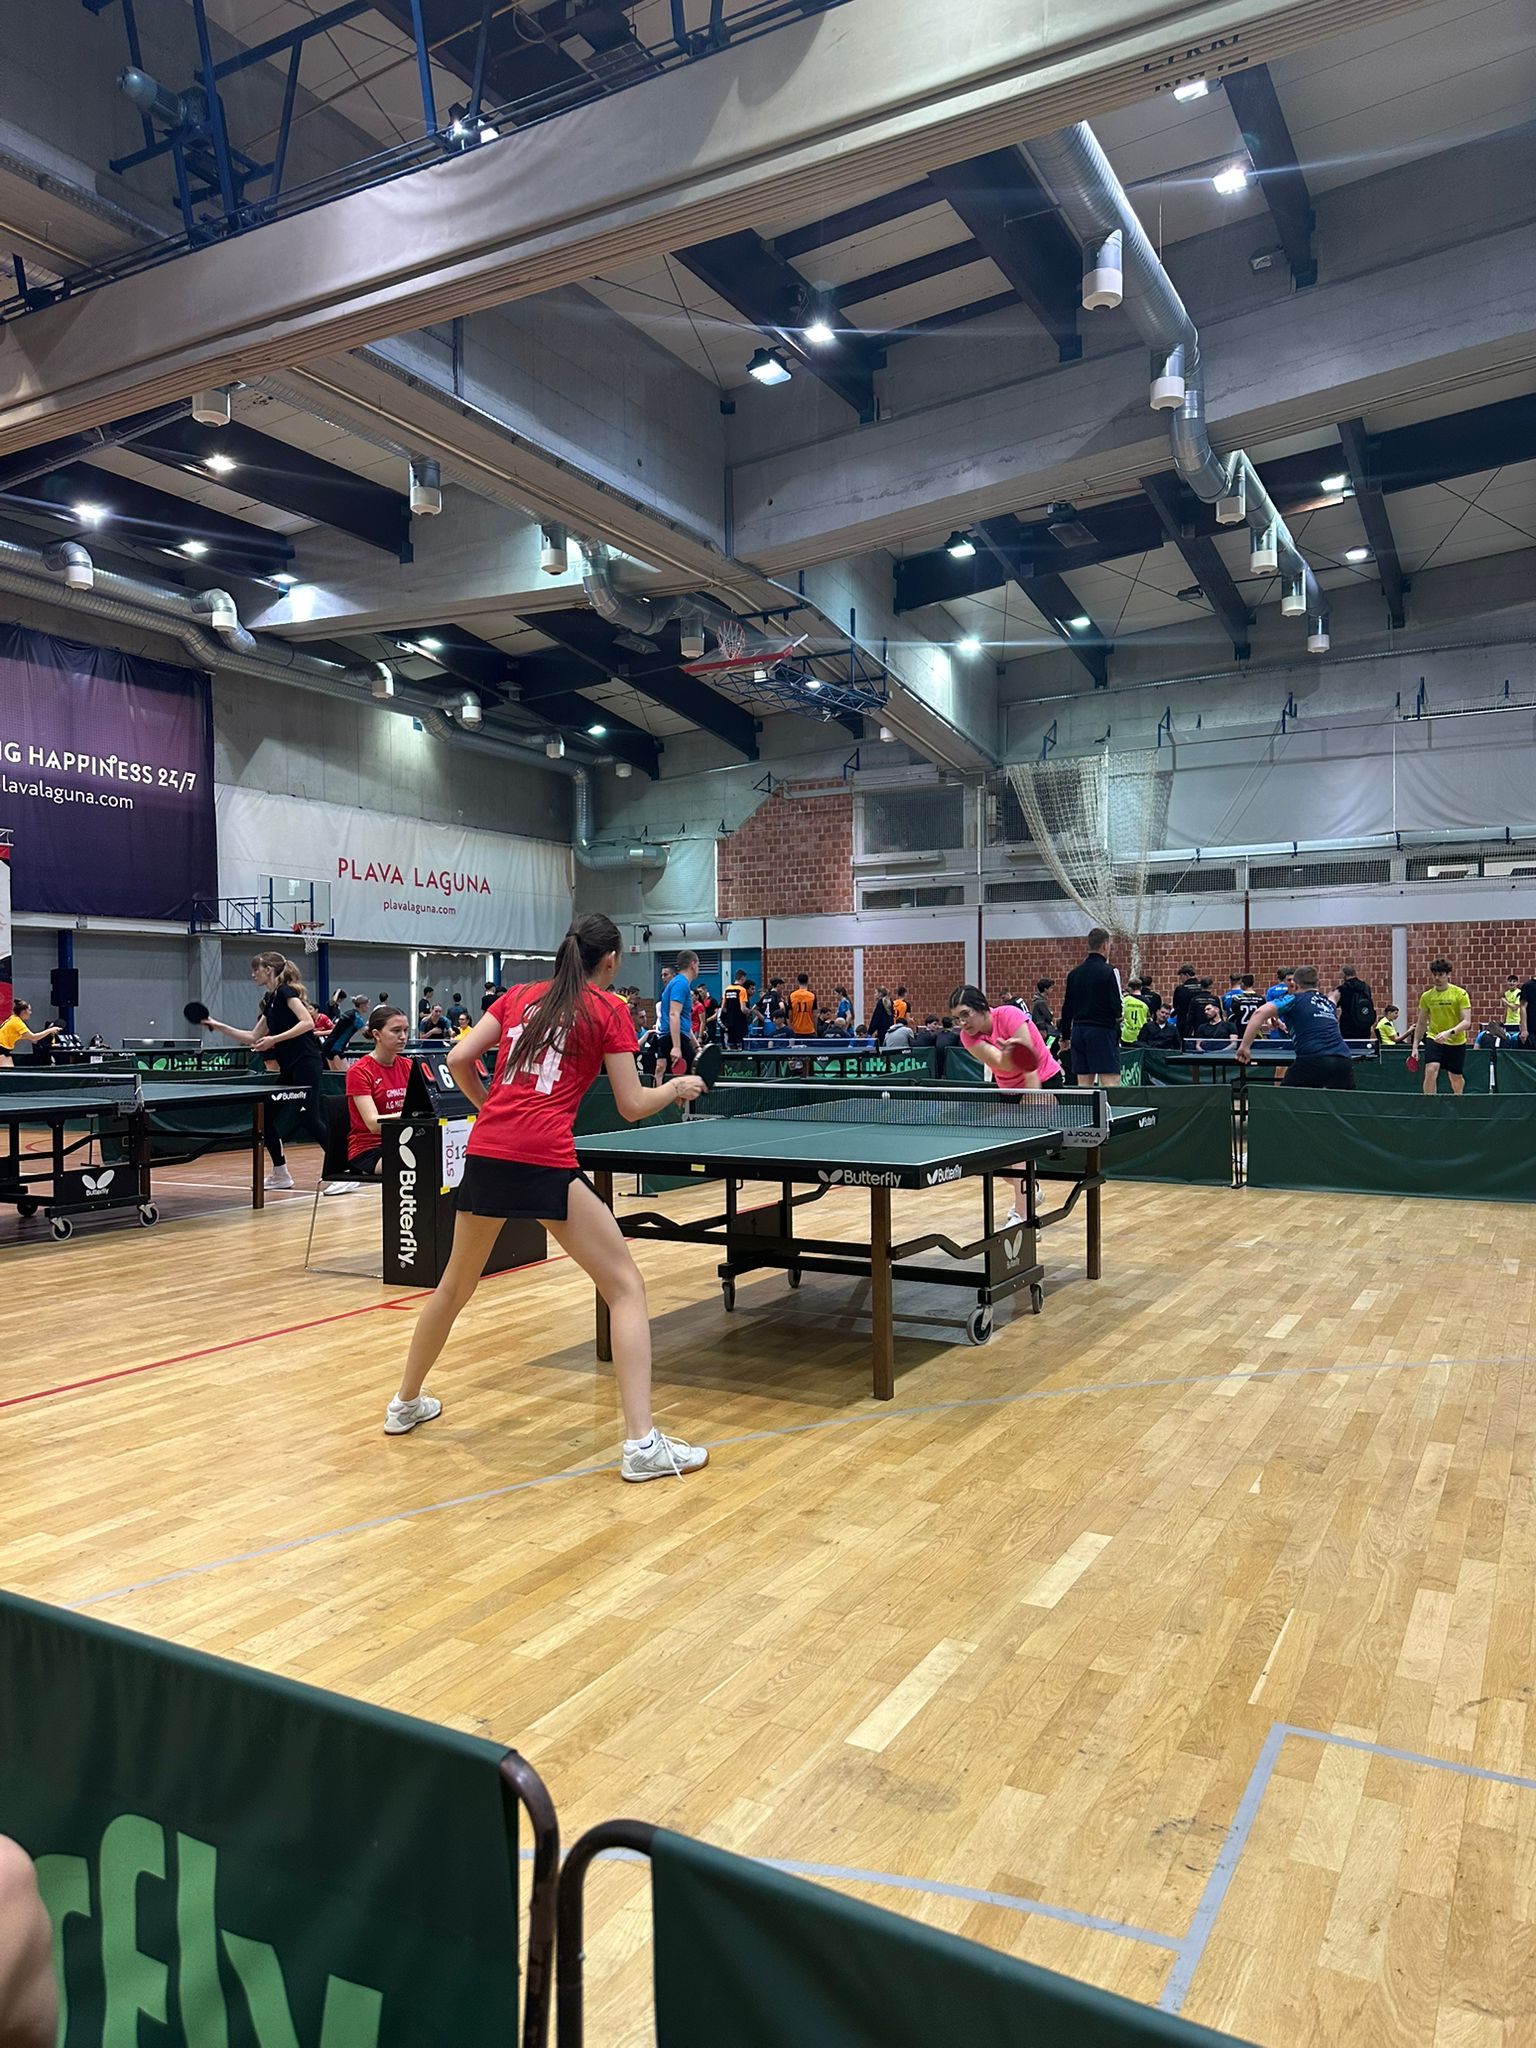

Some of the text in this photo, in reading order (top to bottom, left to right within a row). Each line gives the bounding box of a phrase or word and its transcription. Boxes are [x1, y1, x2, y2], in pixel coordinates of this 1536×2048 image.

[0, 740, 197, 794] G HAPPINESS 24/7
[0, 774, 134, 810] lavalaguna.com
[338, 857, 492, 896] PLAVA LAGUNA
[383, 898, 457, 915] plavalaguna.com
[797, 1002, 808, 1013] 11
[1131, 1010, 1138, 1025] 4
[502, 1022, 563, 1095] 14
[845, 1057, 928, 1079] Butterfly
[438, 1064, 455, 1089] 6
[282, 1091, 308, 1101] Butterfly
[1074, 1130, 1101, 1138] JOOLA
[445, 1140, 455, 1177] STOL
[455, 1144, 468, 1160] 12
[843, 1168, 902, 1188] Butterfly
[938, 1163, 963, 1180] Butterfly
[85, 1188, 110, 1197] Butterfly
[398, 1170, 418, 1268] Butterfly
